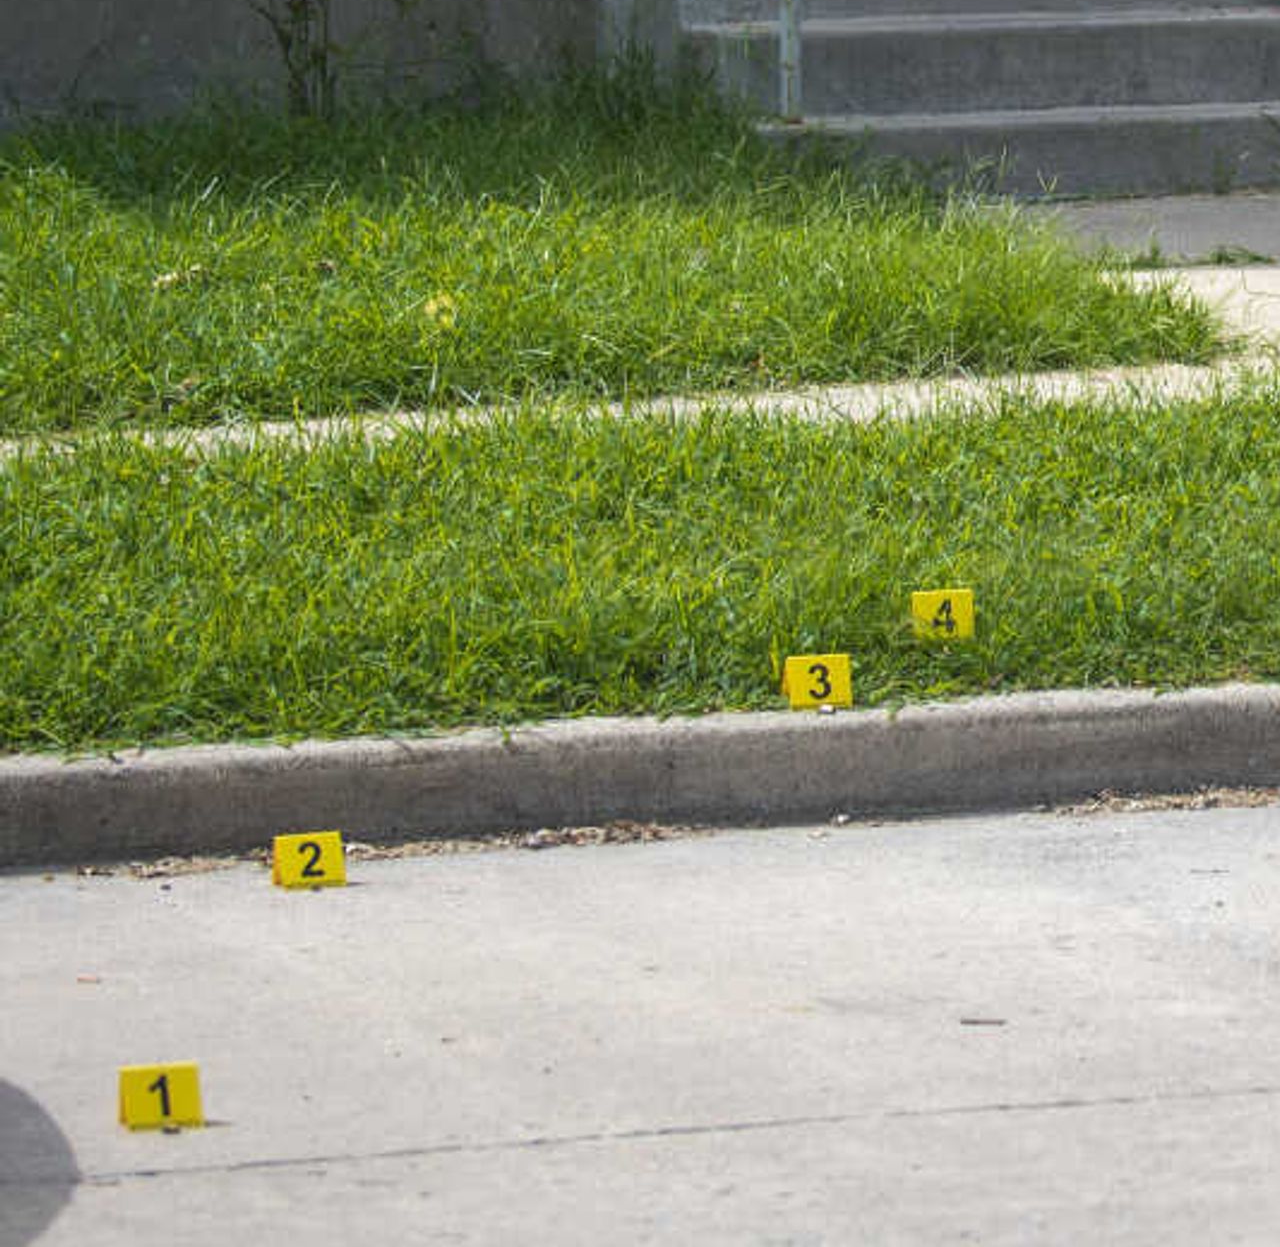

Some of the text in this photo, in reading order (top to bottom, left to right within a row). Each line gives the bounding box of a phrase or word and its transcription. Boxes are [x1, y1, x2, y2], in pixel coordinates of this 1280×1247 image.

[932, 598, 956, 633] 4
[808, 664, 832, 700] 3
[298, 841, 325, 878] 2
[149, 1074, 171, 1118] 1
